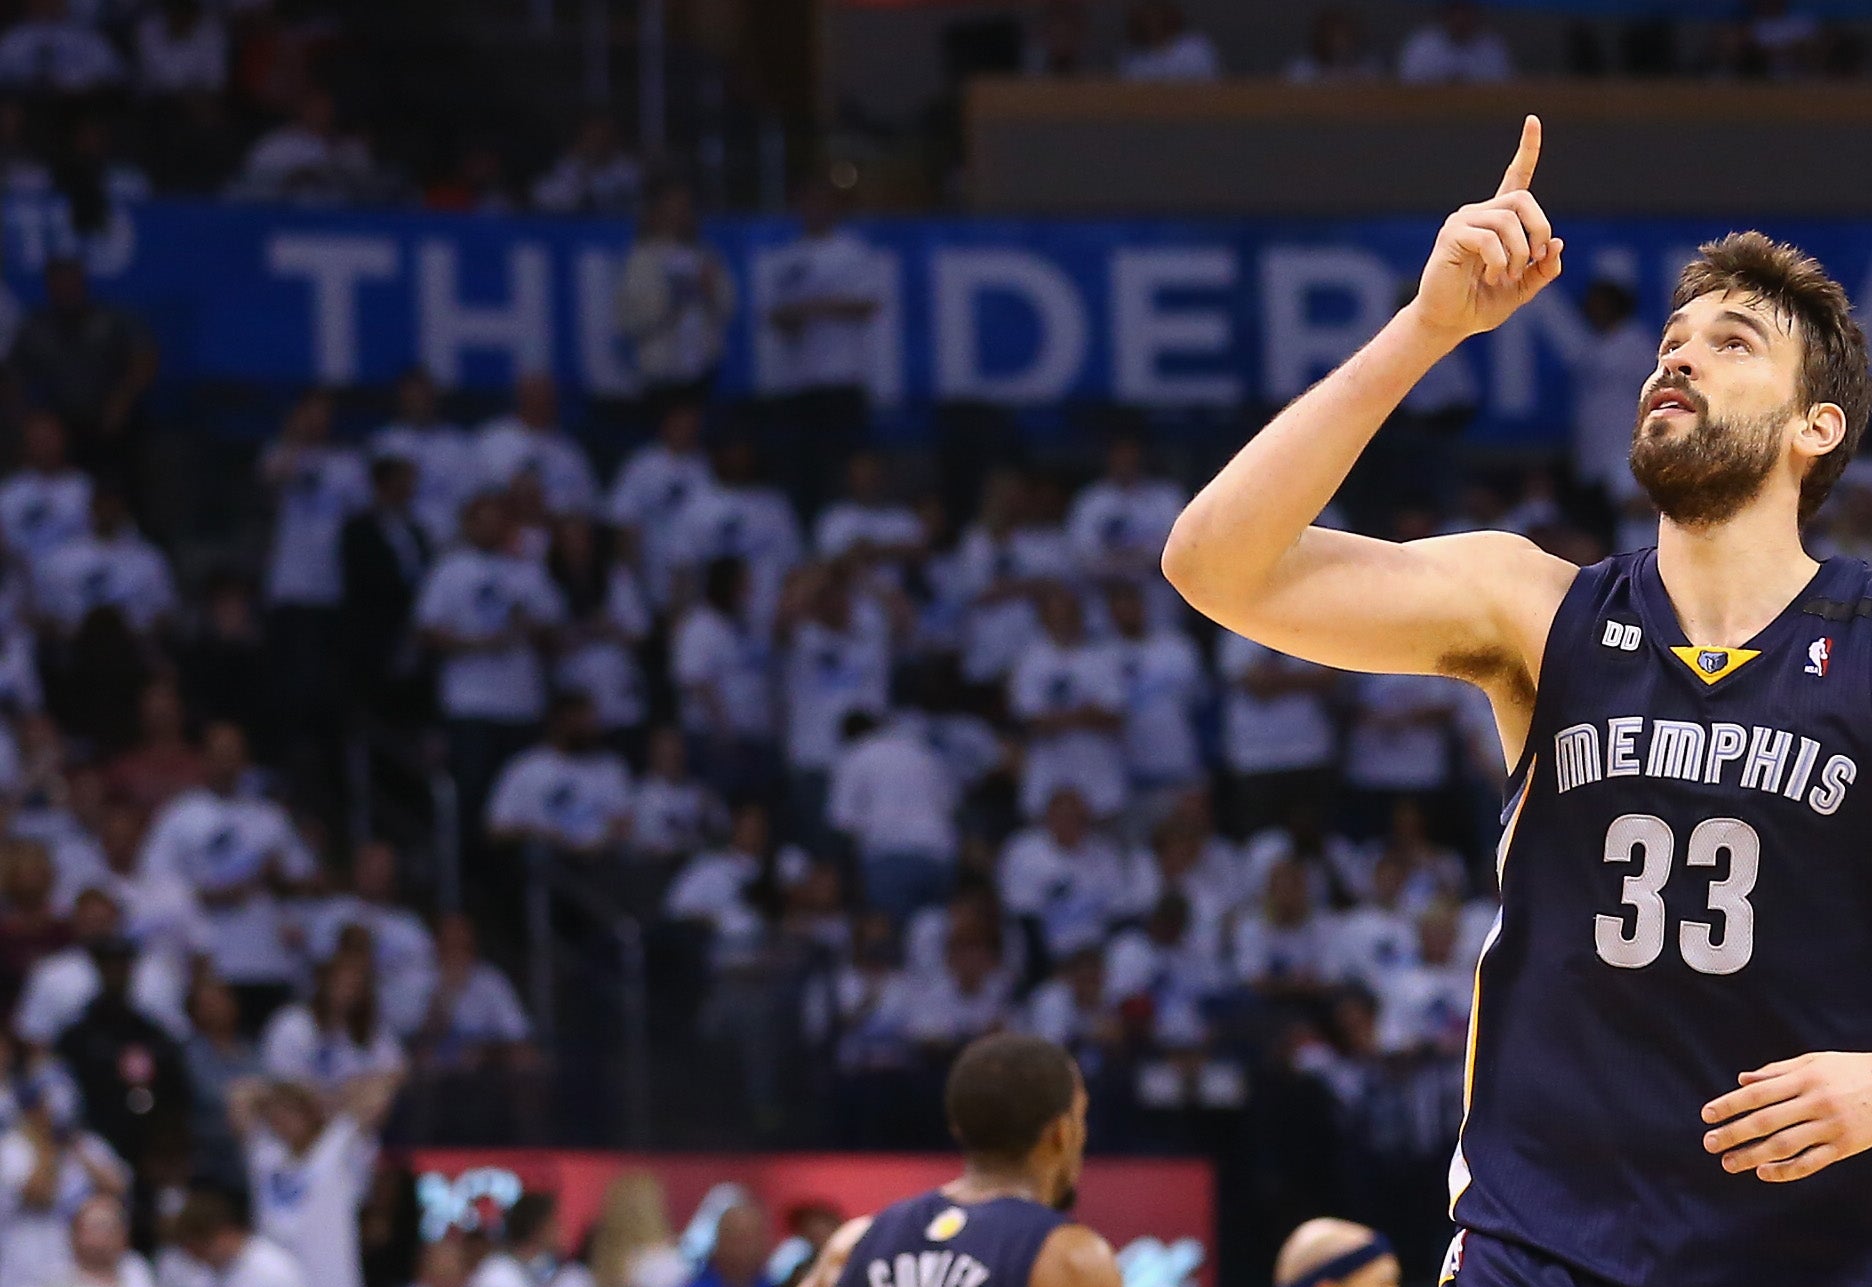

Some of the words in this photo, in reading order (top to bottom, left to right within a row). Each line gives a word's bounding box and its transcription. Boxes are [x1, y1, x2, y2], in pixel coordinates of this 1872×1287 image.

[1601, 619, 1642, 651] DD
[1554, 716, 1858, 815] MEMPHIS
[1594, 814, 1760, 974] 33
